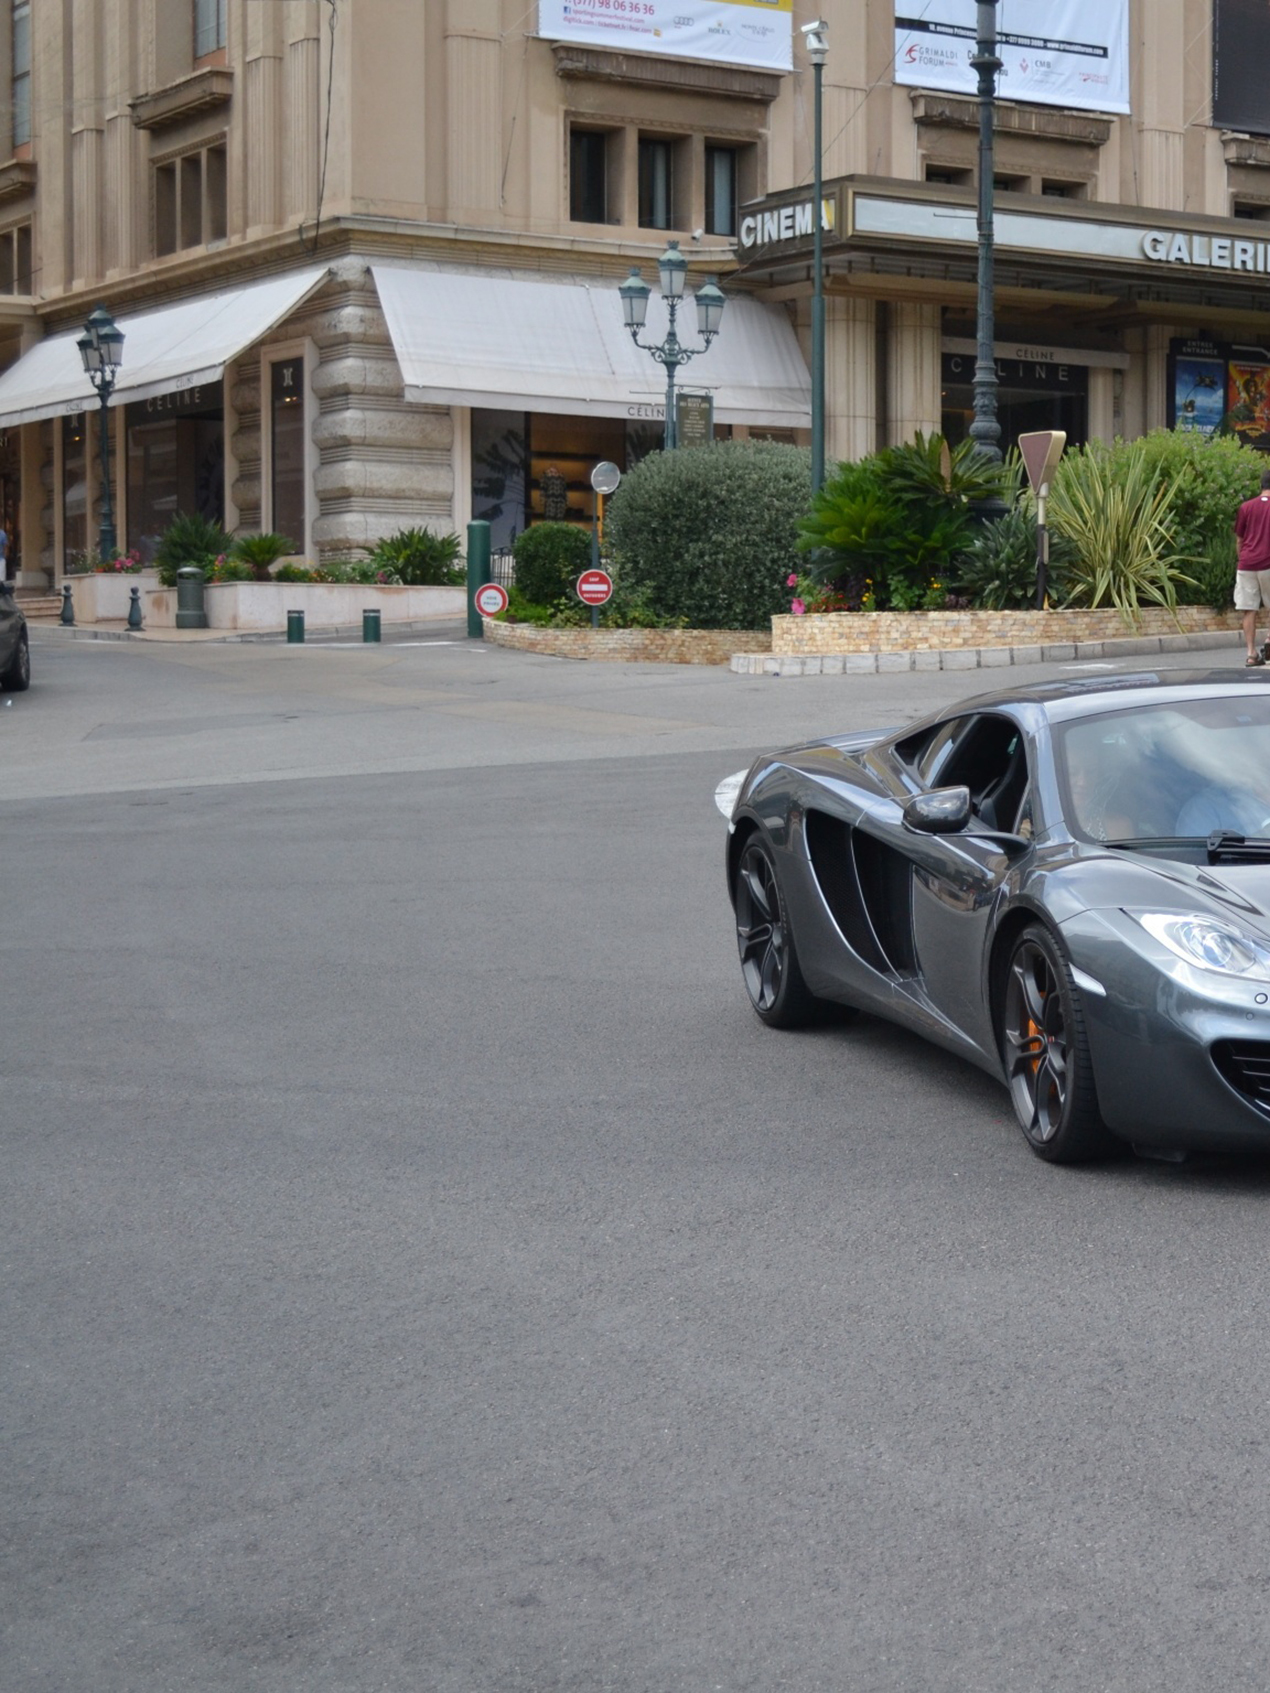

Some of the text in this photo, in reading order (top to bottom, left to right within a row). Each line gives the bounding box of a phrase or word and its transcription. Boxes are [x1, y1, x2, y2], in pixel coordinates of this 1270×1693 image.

[613, 0, 627, 11] 06
[629, 2, 641, 13] 36
[643, 4, 655, 15] 36
[708, 27, 731, 35] ROLEX
[918, 46, 958, 60] GRIMALDI
[918, 57, 945, 68] FORUM
[1035, 59, 1051, 69] CMB
[741, 200, 832, 248] CINEMA
[1016, 349, 1055, 361] CÉLINE
[1182, 347, 1218, 355] ENTRANCE
[951, 357, 1069, 381] CLINE
[627, 404, 666, 418] CÉLIN
